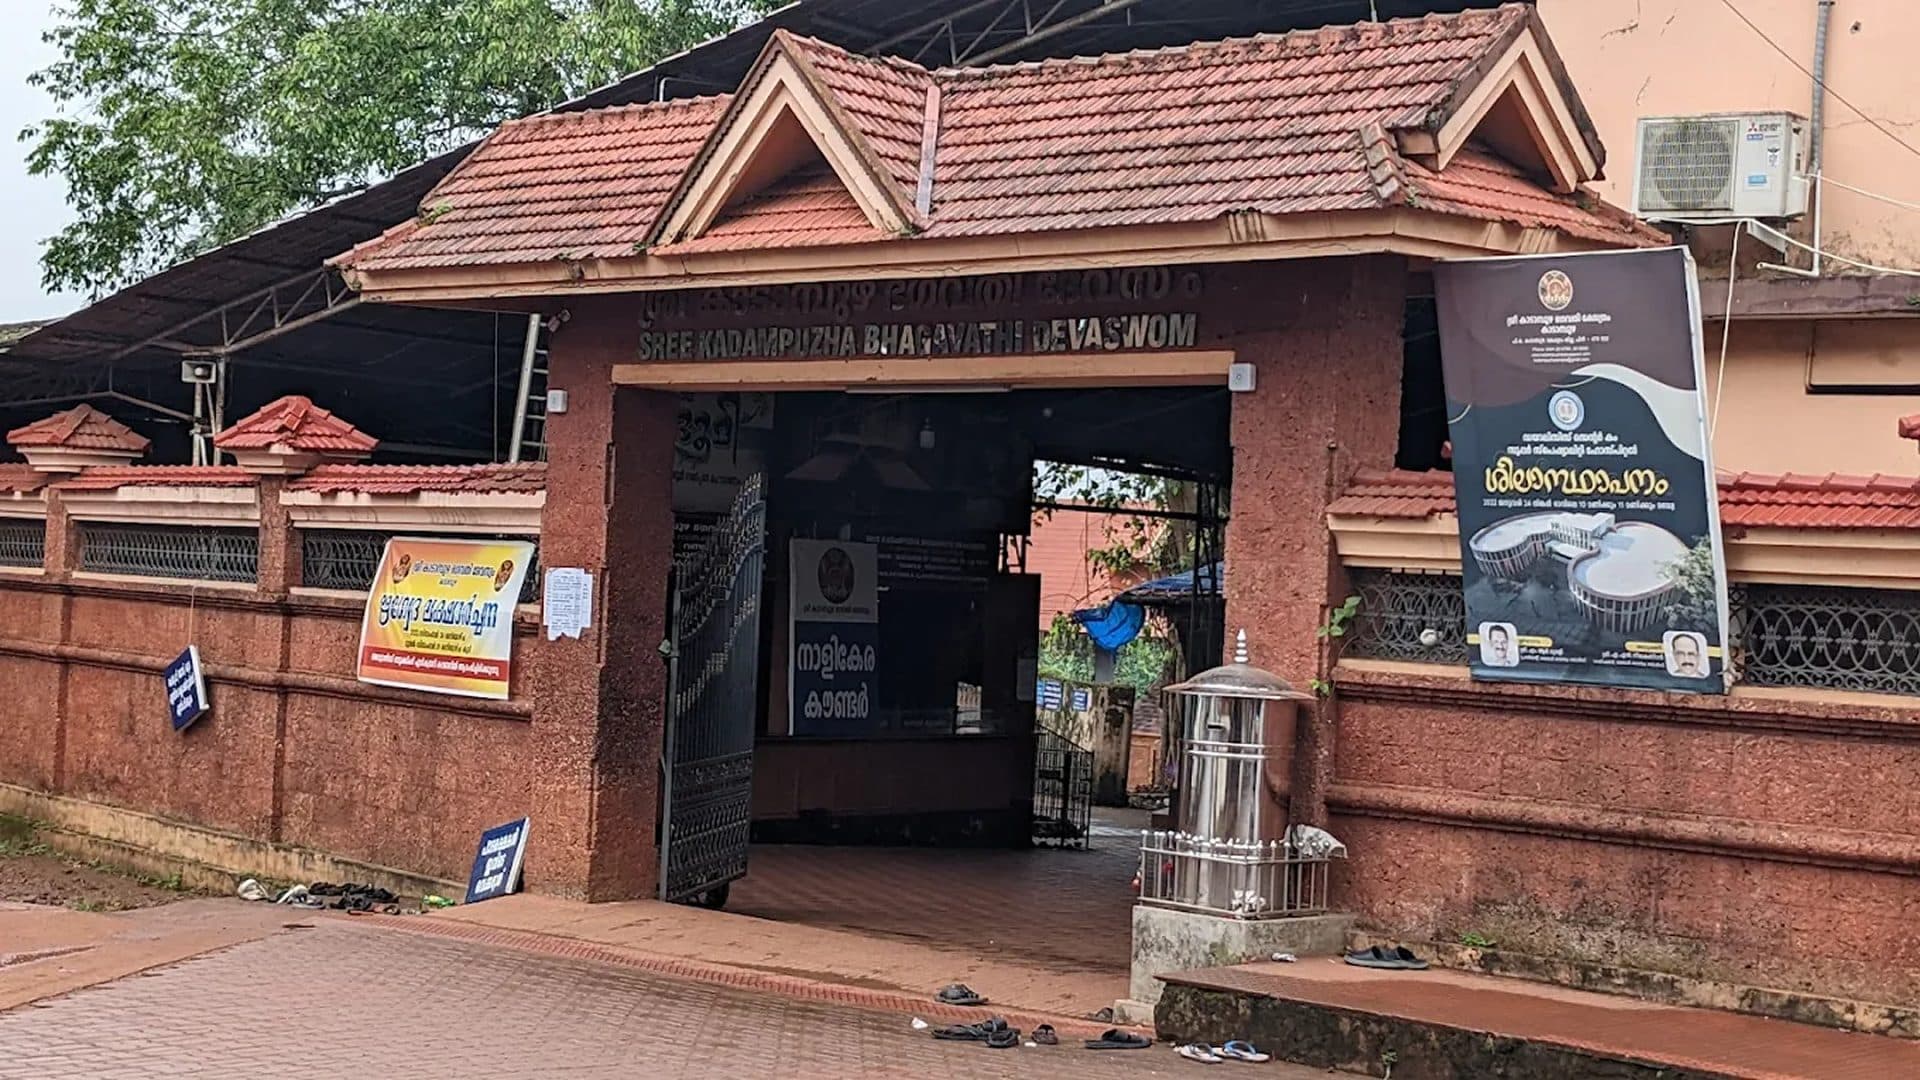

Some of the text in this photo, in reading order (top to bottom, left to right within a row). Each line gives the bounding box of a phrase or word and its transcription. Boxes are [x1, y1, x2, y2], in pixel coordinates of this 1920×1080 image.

[639, 313, 1198, 361] SREE KADAMPUZHA BHAGAVATHI DEVASWOM
[1485, 456, 1670, 496] ശിലാസ്ഥാപനം
[797, 633, 876, 680] നാളികേര
[803, 681, 869, 720] കൗണ്ടർ
